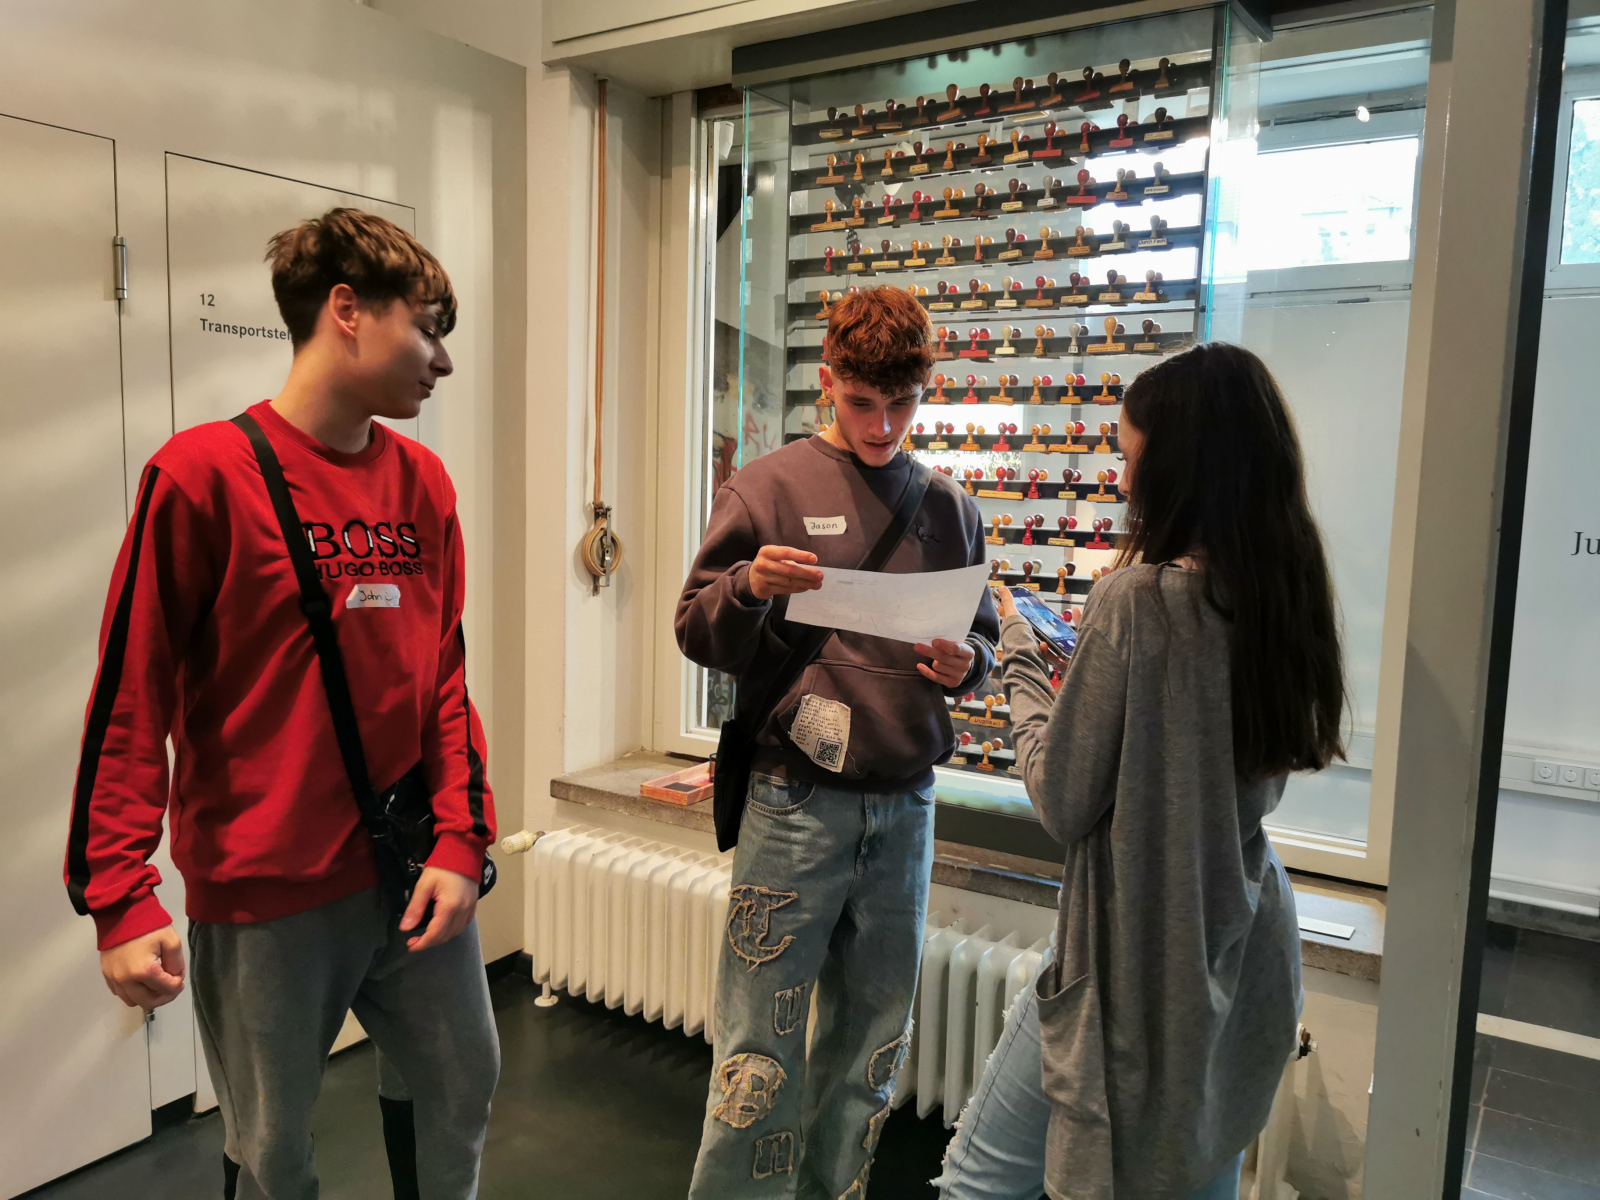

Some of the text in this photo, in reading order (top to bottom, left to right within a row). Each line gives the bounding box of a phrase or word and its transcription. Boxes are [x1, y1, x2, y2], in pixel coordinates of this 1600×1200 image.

[200, 293, 216, 307] 12
[809, 521, 838, 531] Jason
[302, 518, 421, 560] BOSS
[378, 560, 424, 576] BOSS
[359, 589, 383, 602] John
